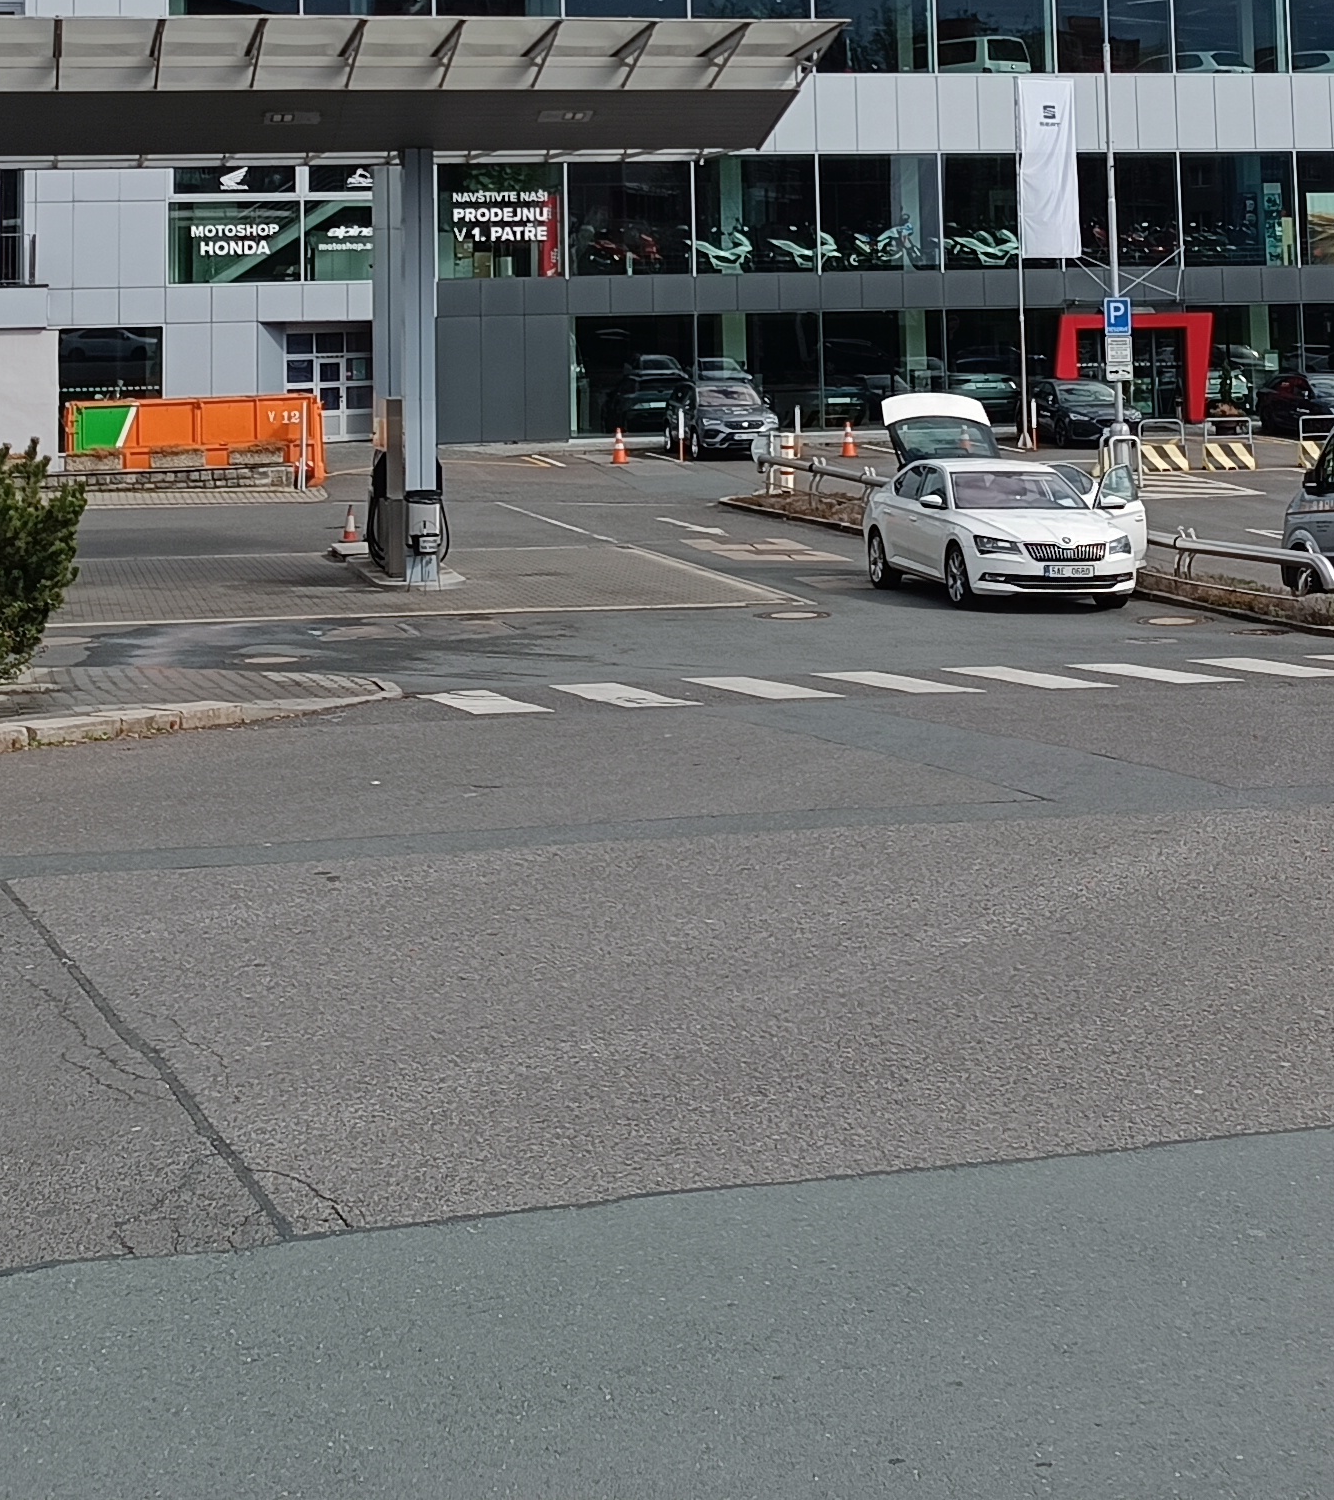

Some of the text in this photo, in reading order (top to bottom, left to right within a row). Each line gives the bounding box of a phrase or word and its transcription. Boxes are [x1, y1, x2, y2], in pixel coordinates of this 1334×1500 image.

[452, 189, 549, 203] NAVŠTIVTE NAŠI
[453, 207, 549, 222] PRODEJNU
[190, 224, 280, 237] MOTOSHOP
[453, 223, 548, 241] V 1. PATŘE
[200, 240, 270, 256] HONDA
[1109, 302, 1125, 324] P
[281, 410, 300, 424] 12
